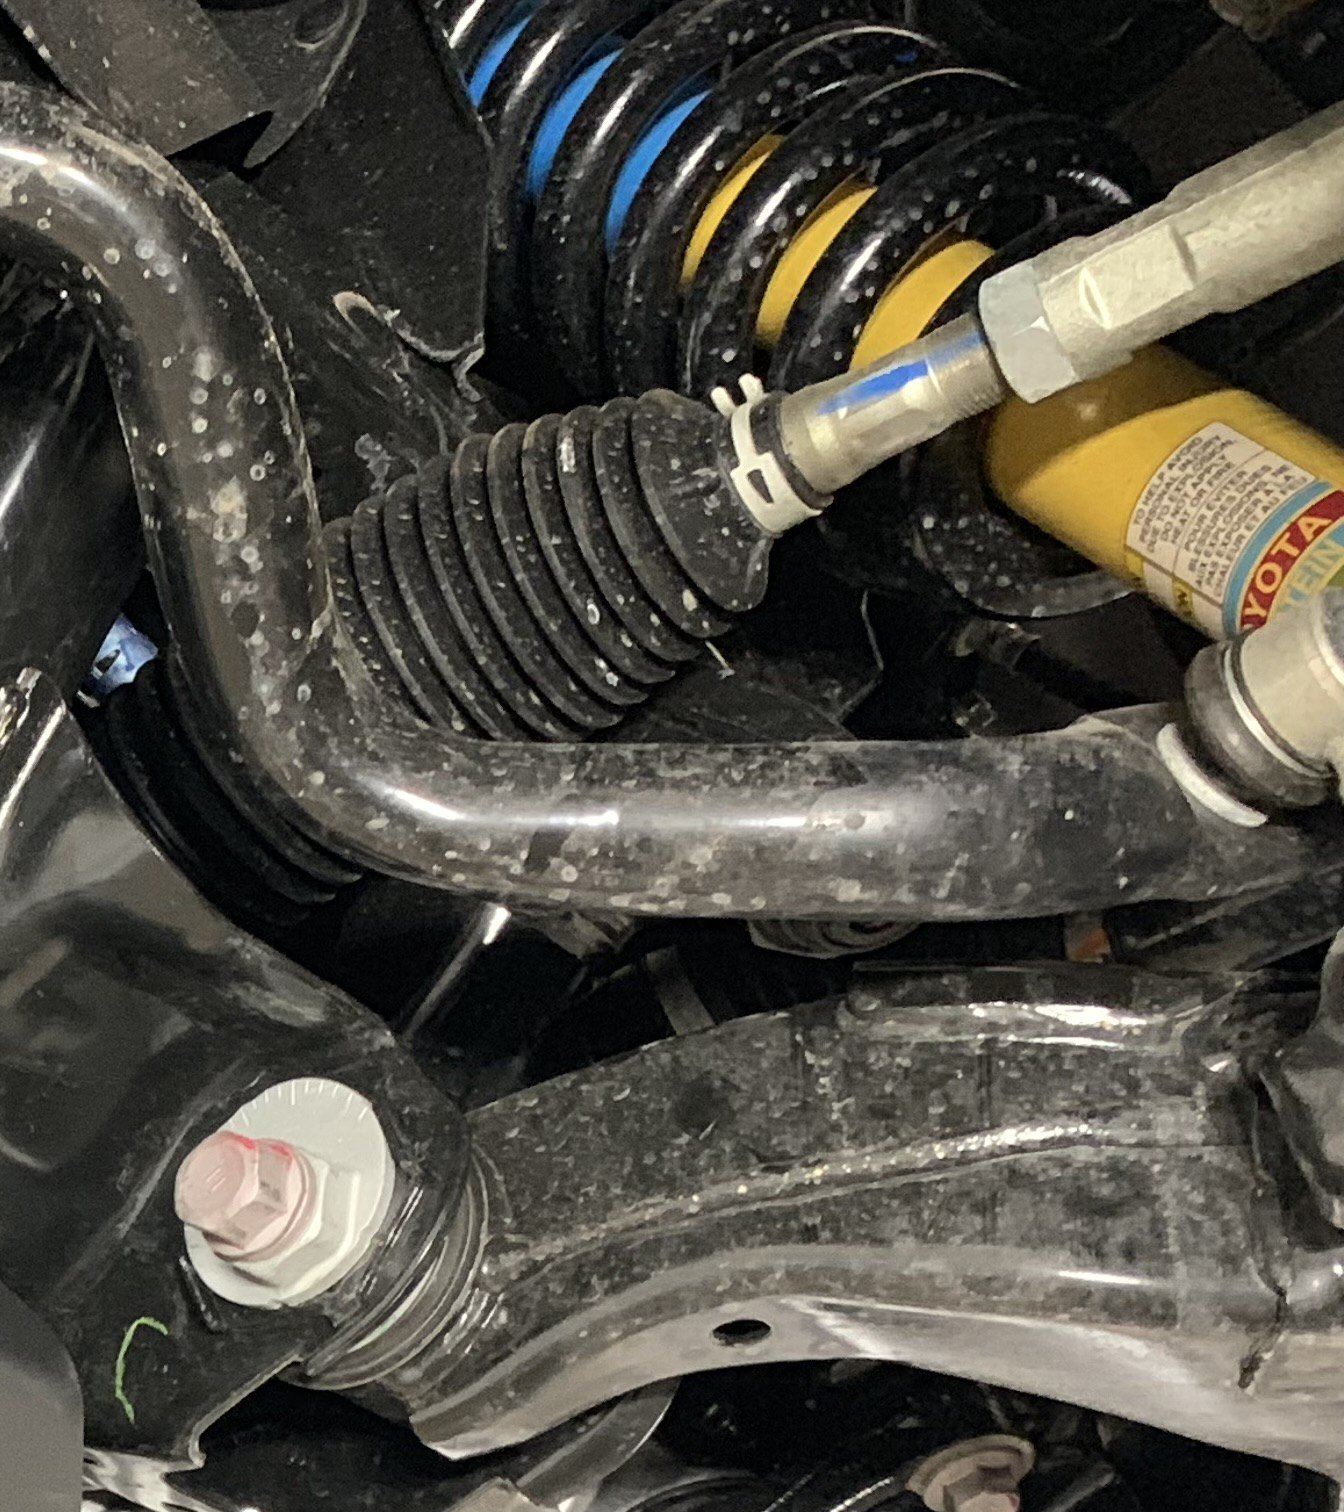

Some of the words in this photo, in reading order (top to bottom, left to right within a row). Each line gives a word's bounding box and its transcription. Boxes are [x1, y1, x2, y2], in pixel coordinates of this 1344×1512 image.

[1142, 471, 1165, 506] HELP
[1171, 491, 1190, 518] NOT
[1190, 453, 1227, 489] APPLY
[1170, 510, 1189, 544] HEAT
[1182, 512, 1207, 552] POUR
